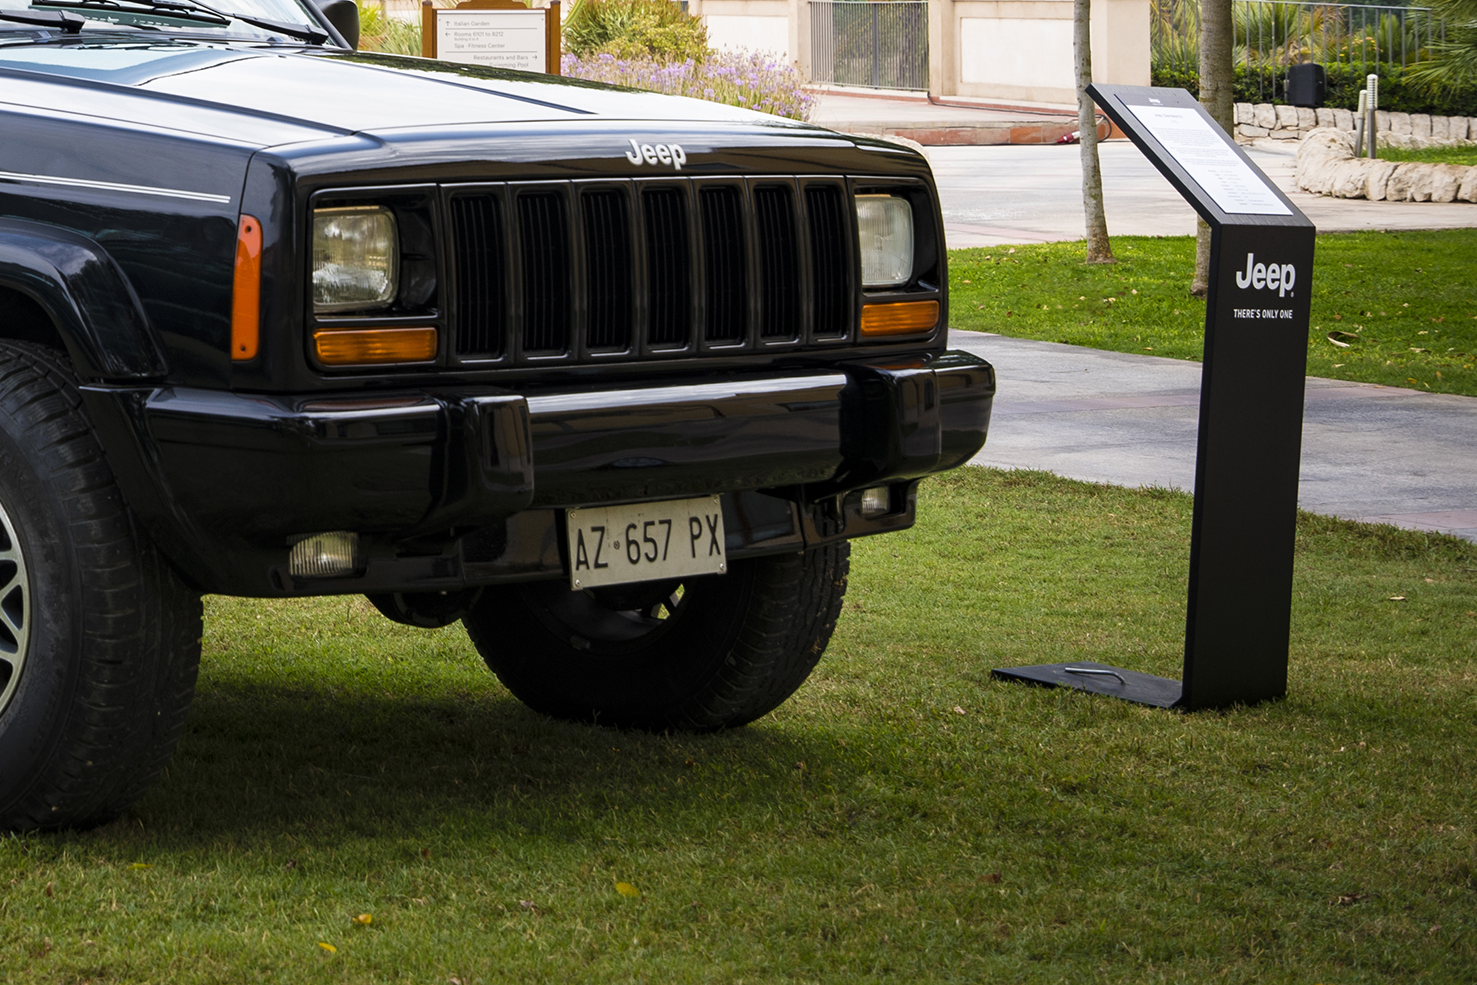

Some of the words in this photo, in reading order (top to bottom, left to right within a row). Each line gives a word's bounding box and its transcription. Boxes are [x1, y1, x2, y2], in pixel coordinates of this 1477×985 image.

[625, 138, 687, 171] Jeep
[1235, 252, 1297, 298] Jeep
[1233, 308, 1261, 319] THERE'S
[1261, 308, 1279, 319] ONLY
[1279, 309, 1293, 319] ONE
[575, 525, 609, 571] AZ
[624, 518, 673, 565] 657
[688, 513, 721, 559] PX
